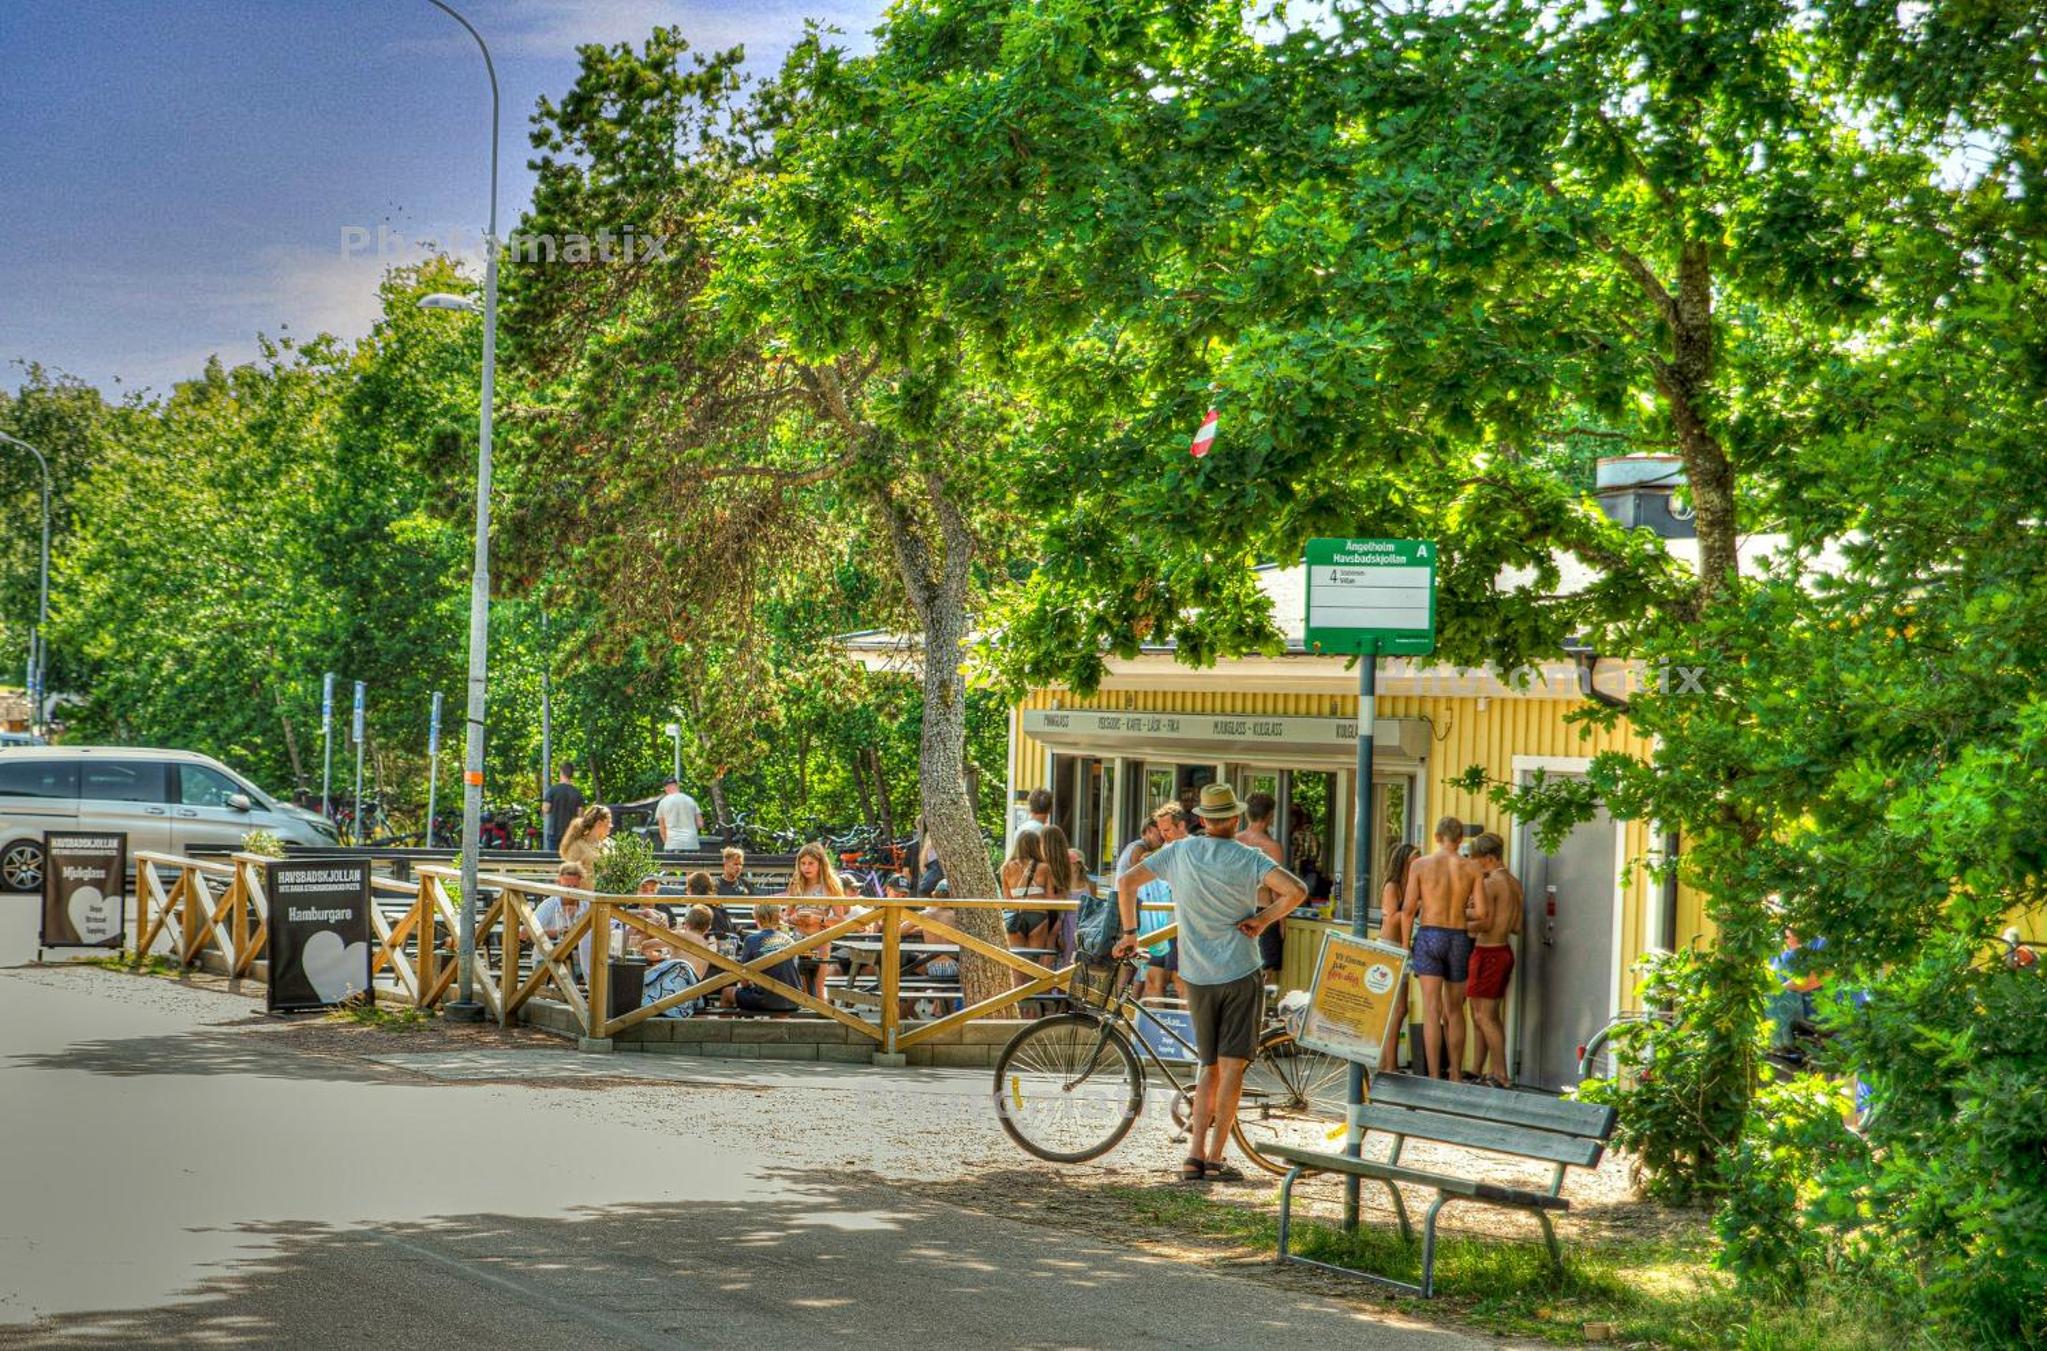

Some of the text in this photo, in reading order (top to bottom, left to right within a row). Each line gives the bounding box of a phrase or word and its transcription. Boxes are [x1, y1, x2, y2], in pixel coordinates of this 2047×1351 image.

[1346, 539, 1395, 552] Ängelholm
[1416, 544, 1428, 558] A
[1333, 553, 1407, 565] Havsbadskjollan
[1329, 569, 1338, 583] 4
[278, 869, 361, 884] HAVSBADSKJOLLAN
[288, 906, 353, 923] Hamburgare
